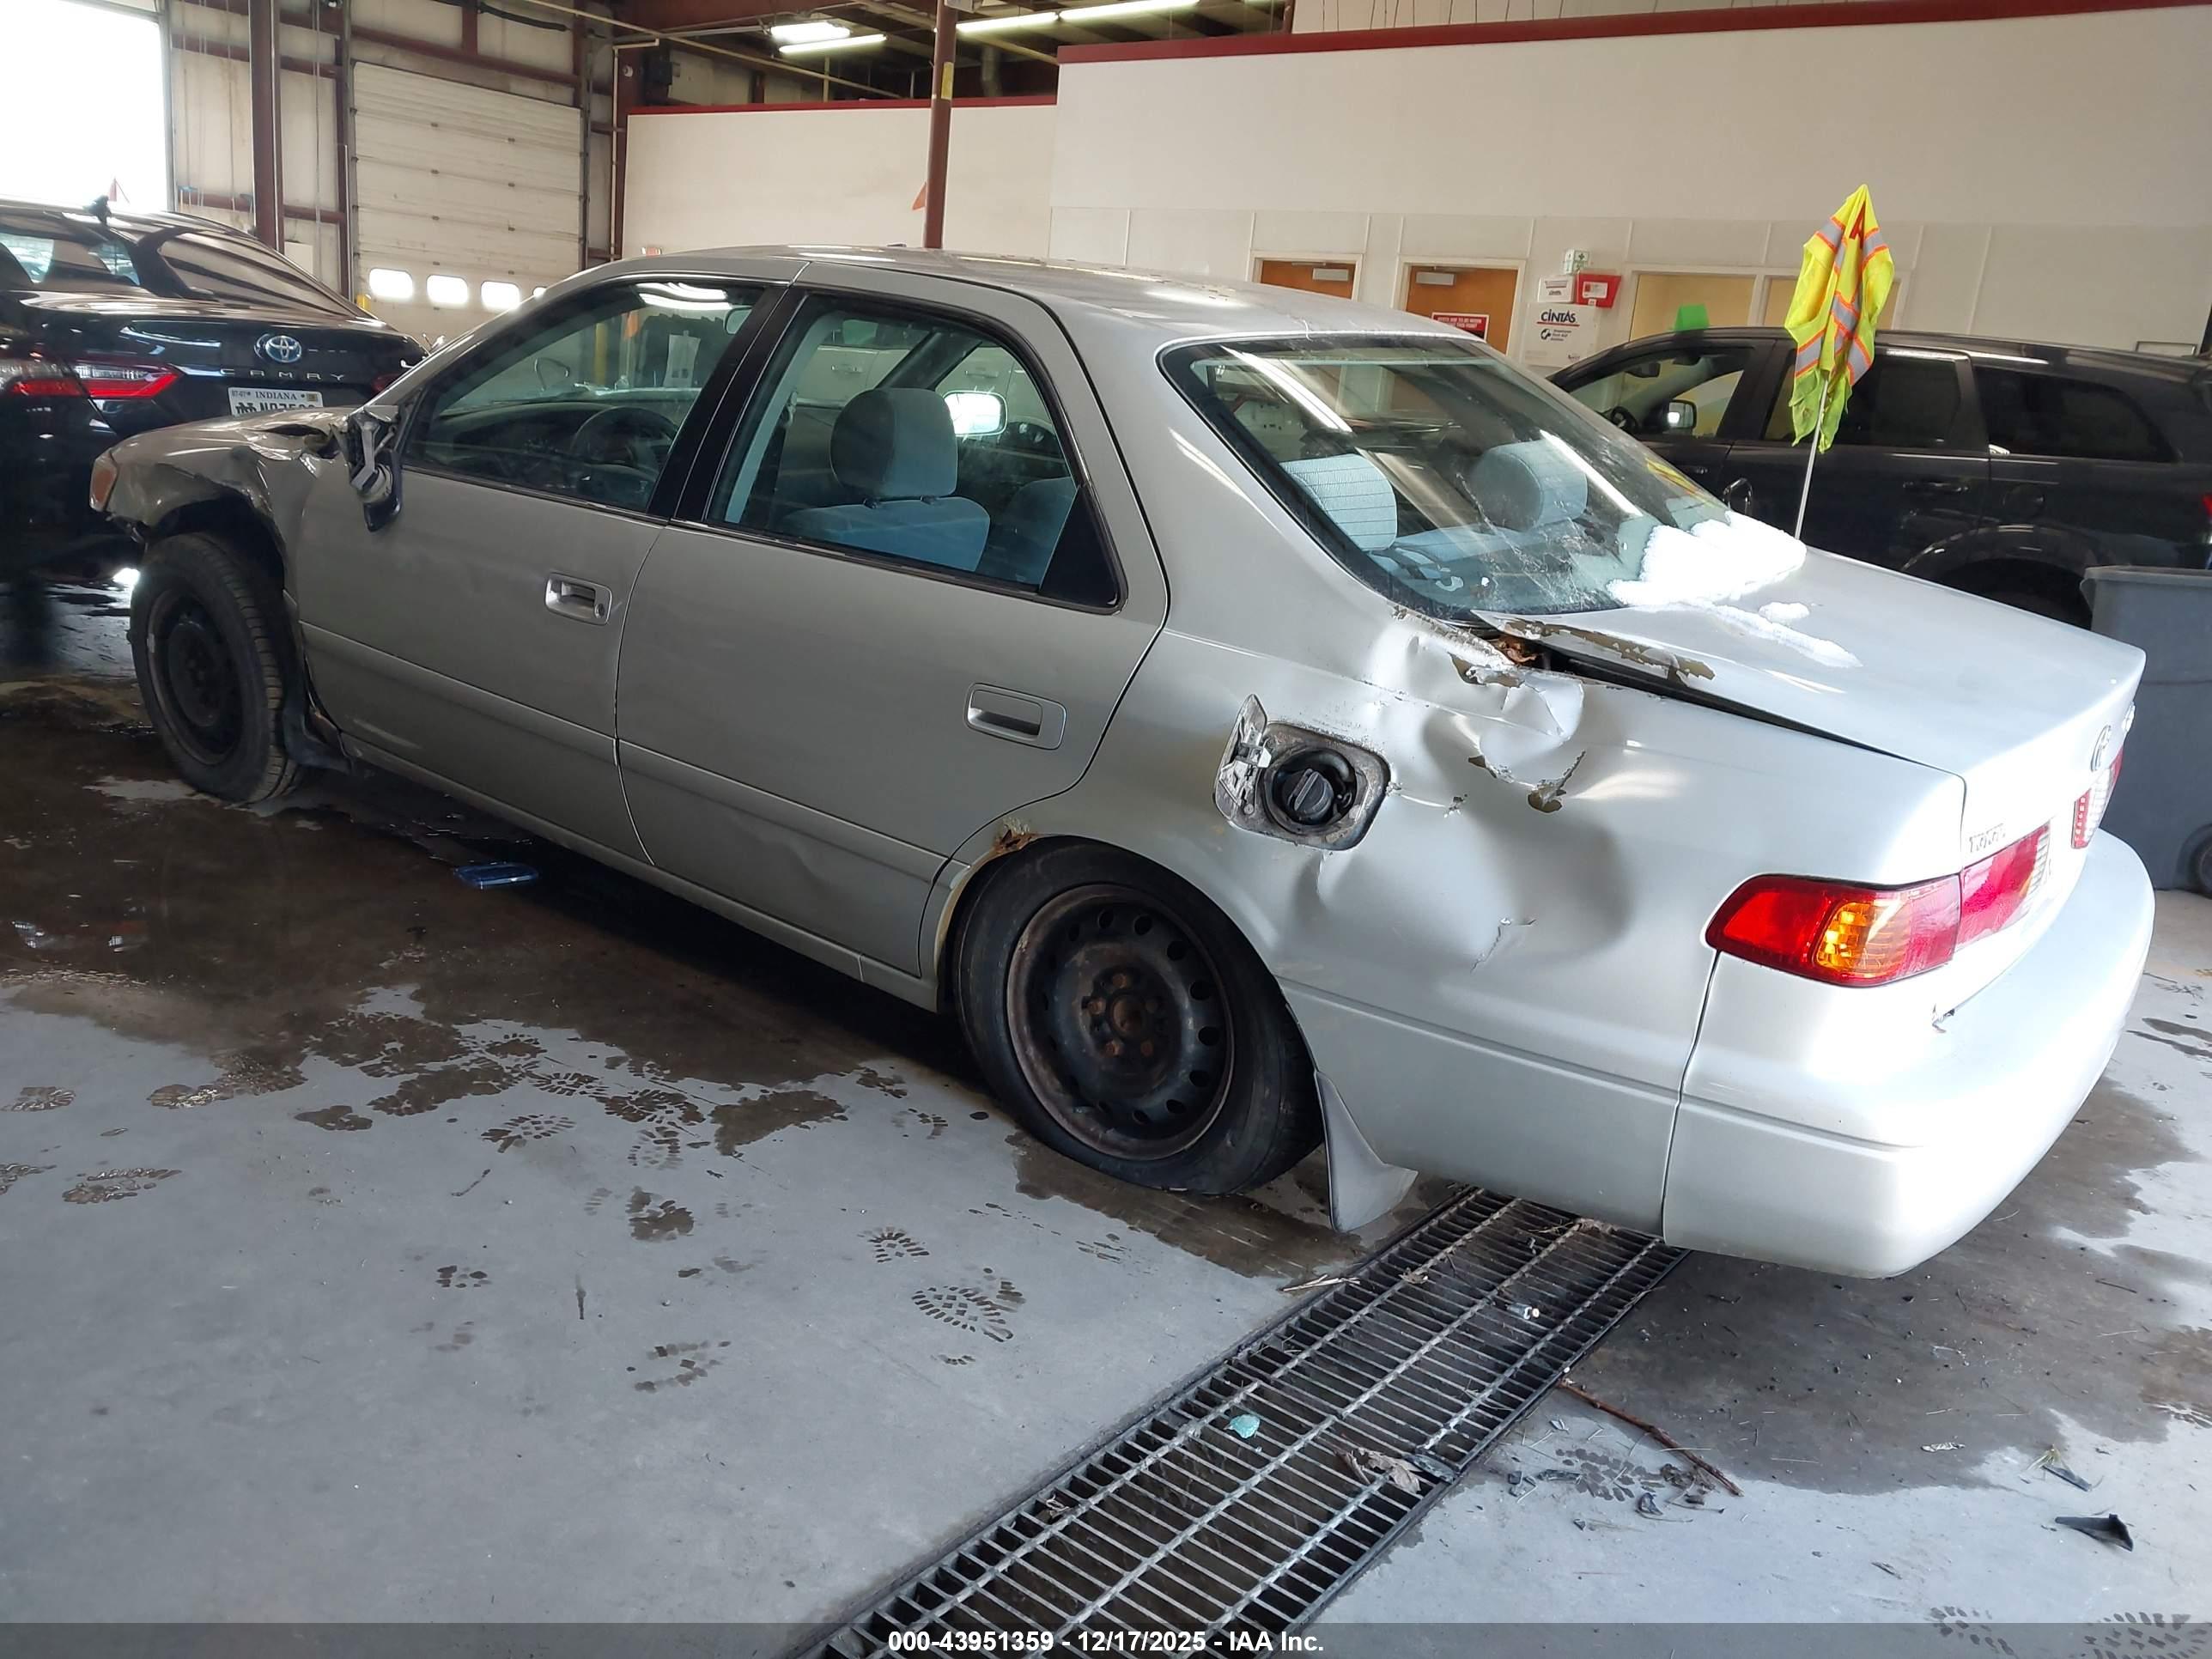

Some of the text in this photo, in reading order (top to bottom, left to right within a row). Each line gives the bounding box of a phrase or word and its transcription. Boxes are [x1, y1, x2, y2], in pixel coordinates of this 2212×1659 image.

[1541, 309, 1577, 323] CINTAS
[220, 368, 344, 380] CAMRY
[255, 391, 298, 401] INDIANA
